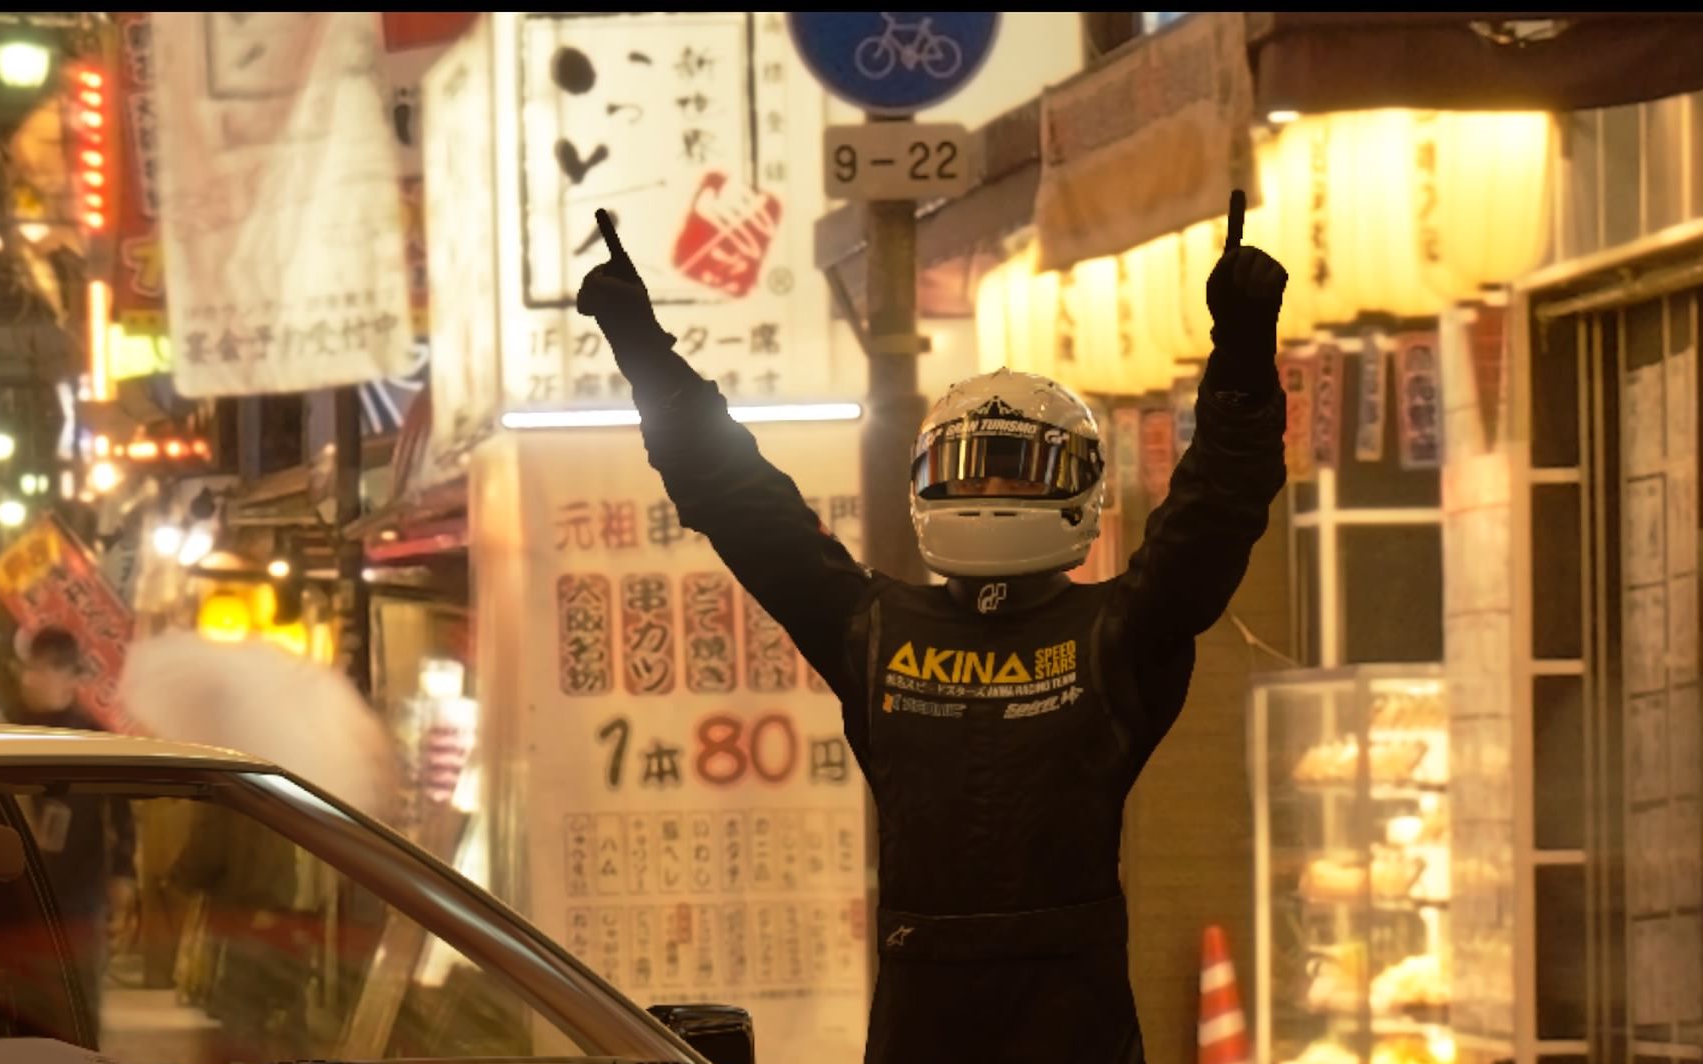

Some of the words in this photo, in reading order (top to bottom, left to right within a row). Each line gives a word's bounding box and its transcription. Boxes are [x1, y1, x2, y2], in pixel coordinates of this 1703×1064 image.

[834, 140, 958, 182] 9-22
[981, 418, 1039, 435] TURISMO
[626, 577, 670, 692] 串カツ
[887, 640, 1032, 684] AKINA
[1035, 640, 1076, 665] SPEED
[1035, 657, 1076, 681] STARS
